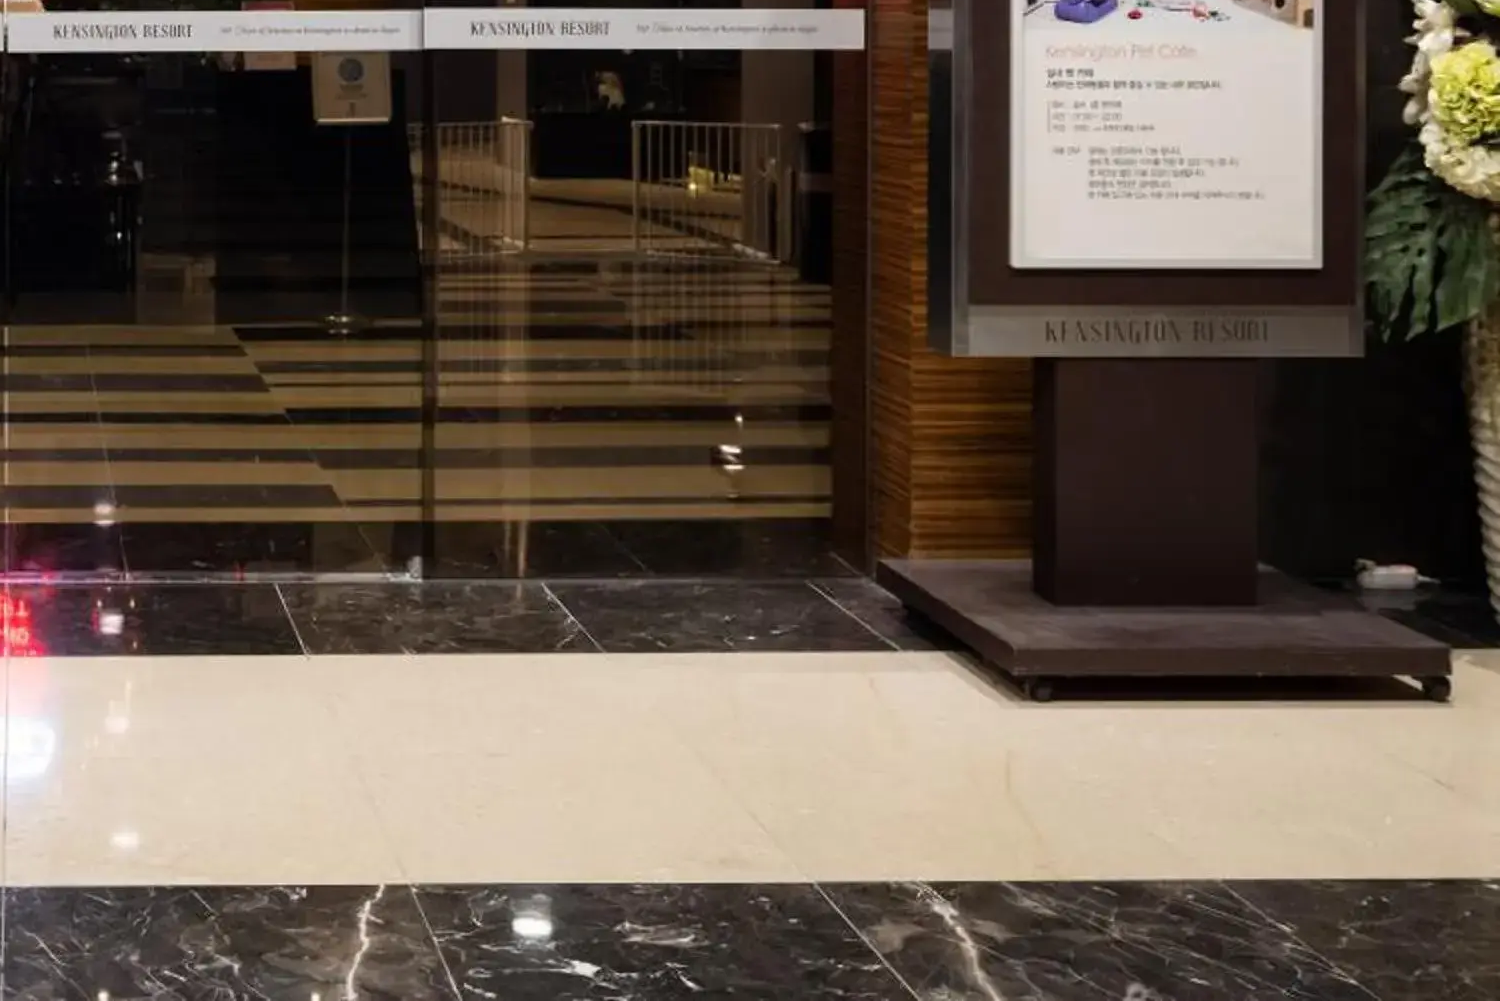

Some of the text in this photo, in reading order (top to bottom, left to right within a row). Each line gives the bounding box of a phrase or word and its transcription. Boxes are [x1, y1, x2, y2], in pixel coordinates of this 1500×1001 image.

[53, 24, 193, 40] KENSINGTON RESORT
[470, 21, 610, 38] KENSINGTON RESORT
[1045, 43, 1198, 63] Kensington Pet Cafe
[1045, 320, 1271, 345] KENSINGTON RESORT
